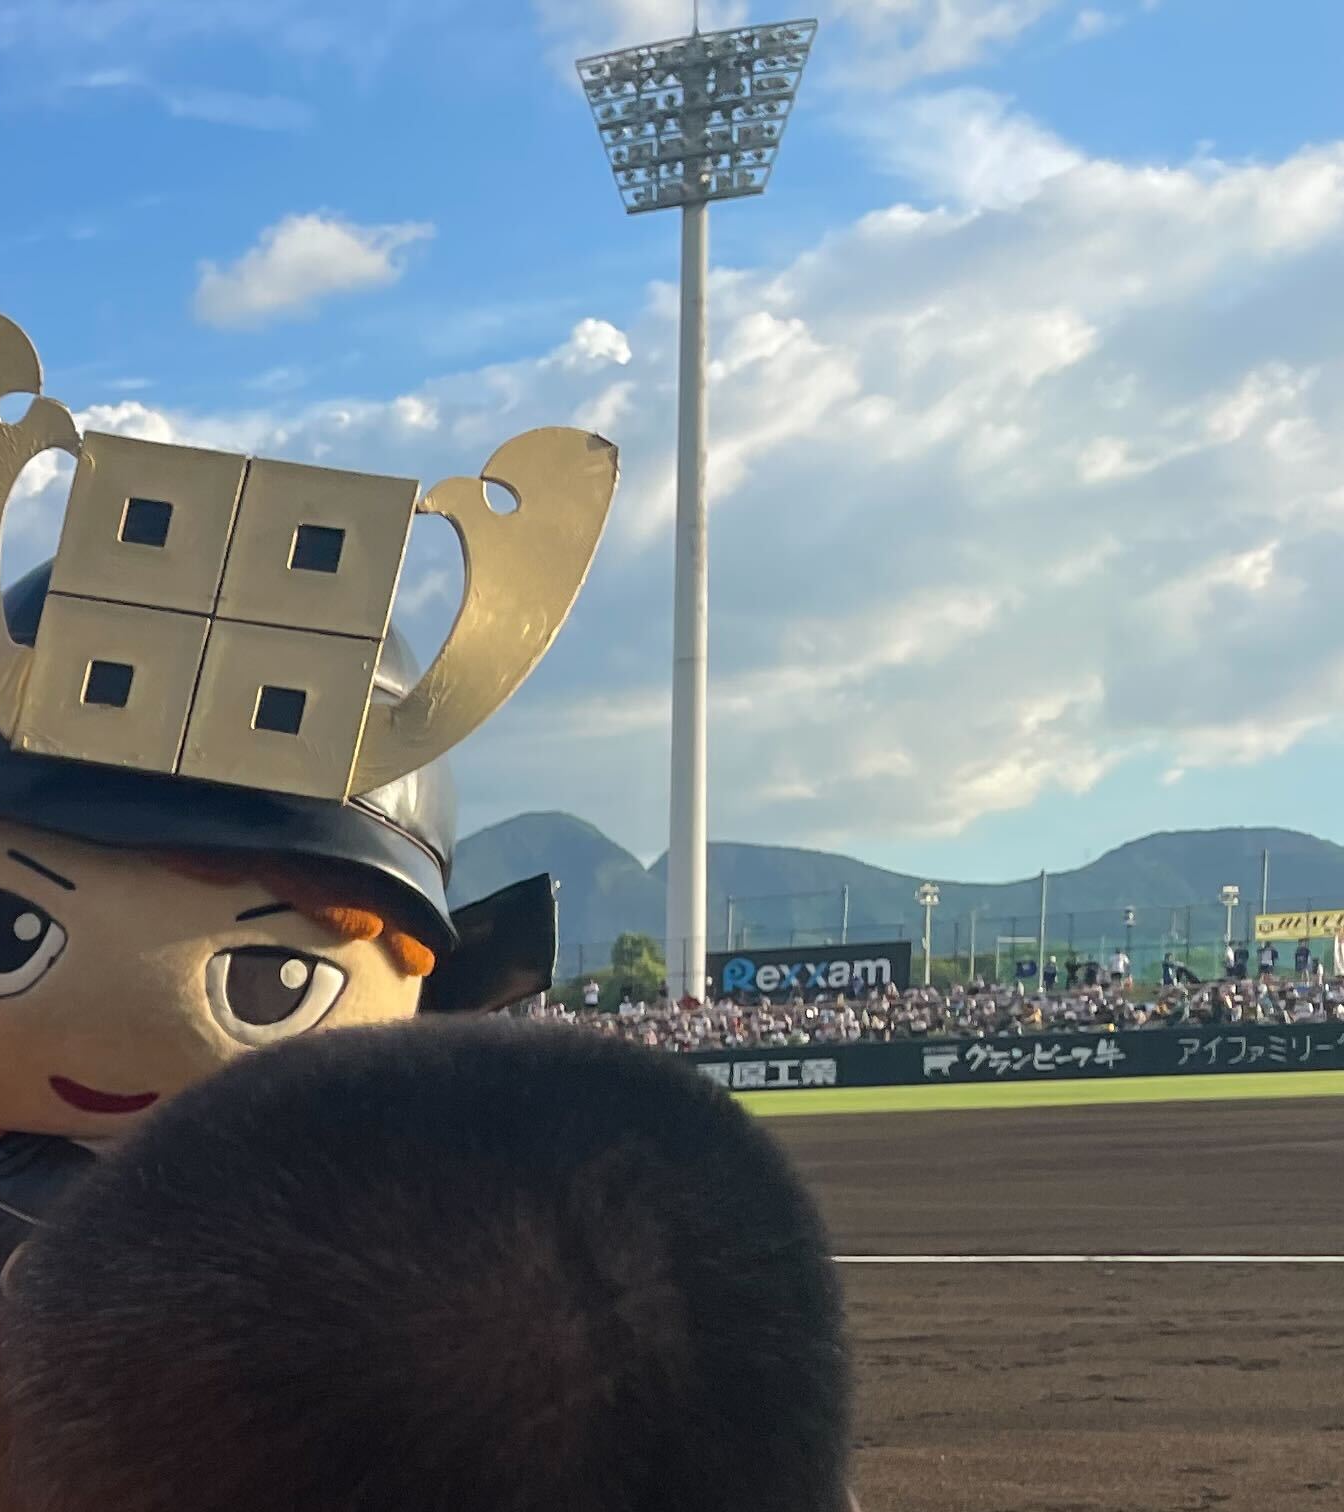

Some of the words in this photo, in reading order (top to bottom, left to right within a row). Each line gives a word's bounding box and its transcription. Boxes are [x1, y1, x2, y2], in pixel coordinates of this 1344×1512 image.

[722, 956, 892, 993] Rexxam
[1177, 1034, 1344, 1066] アイファミリー
